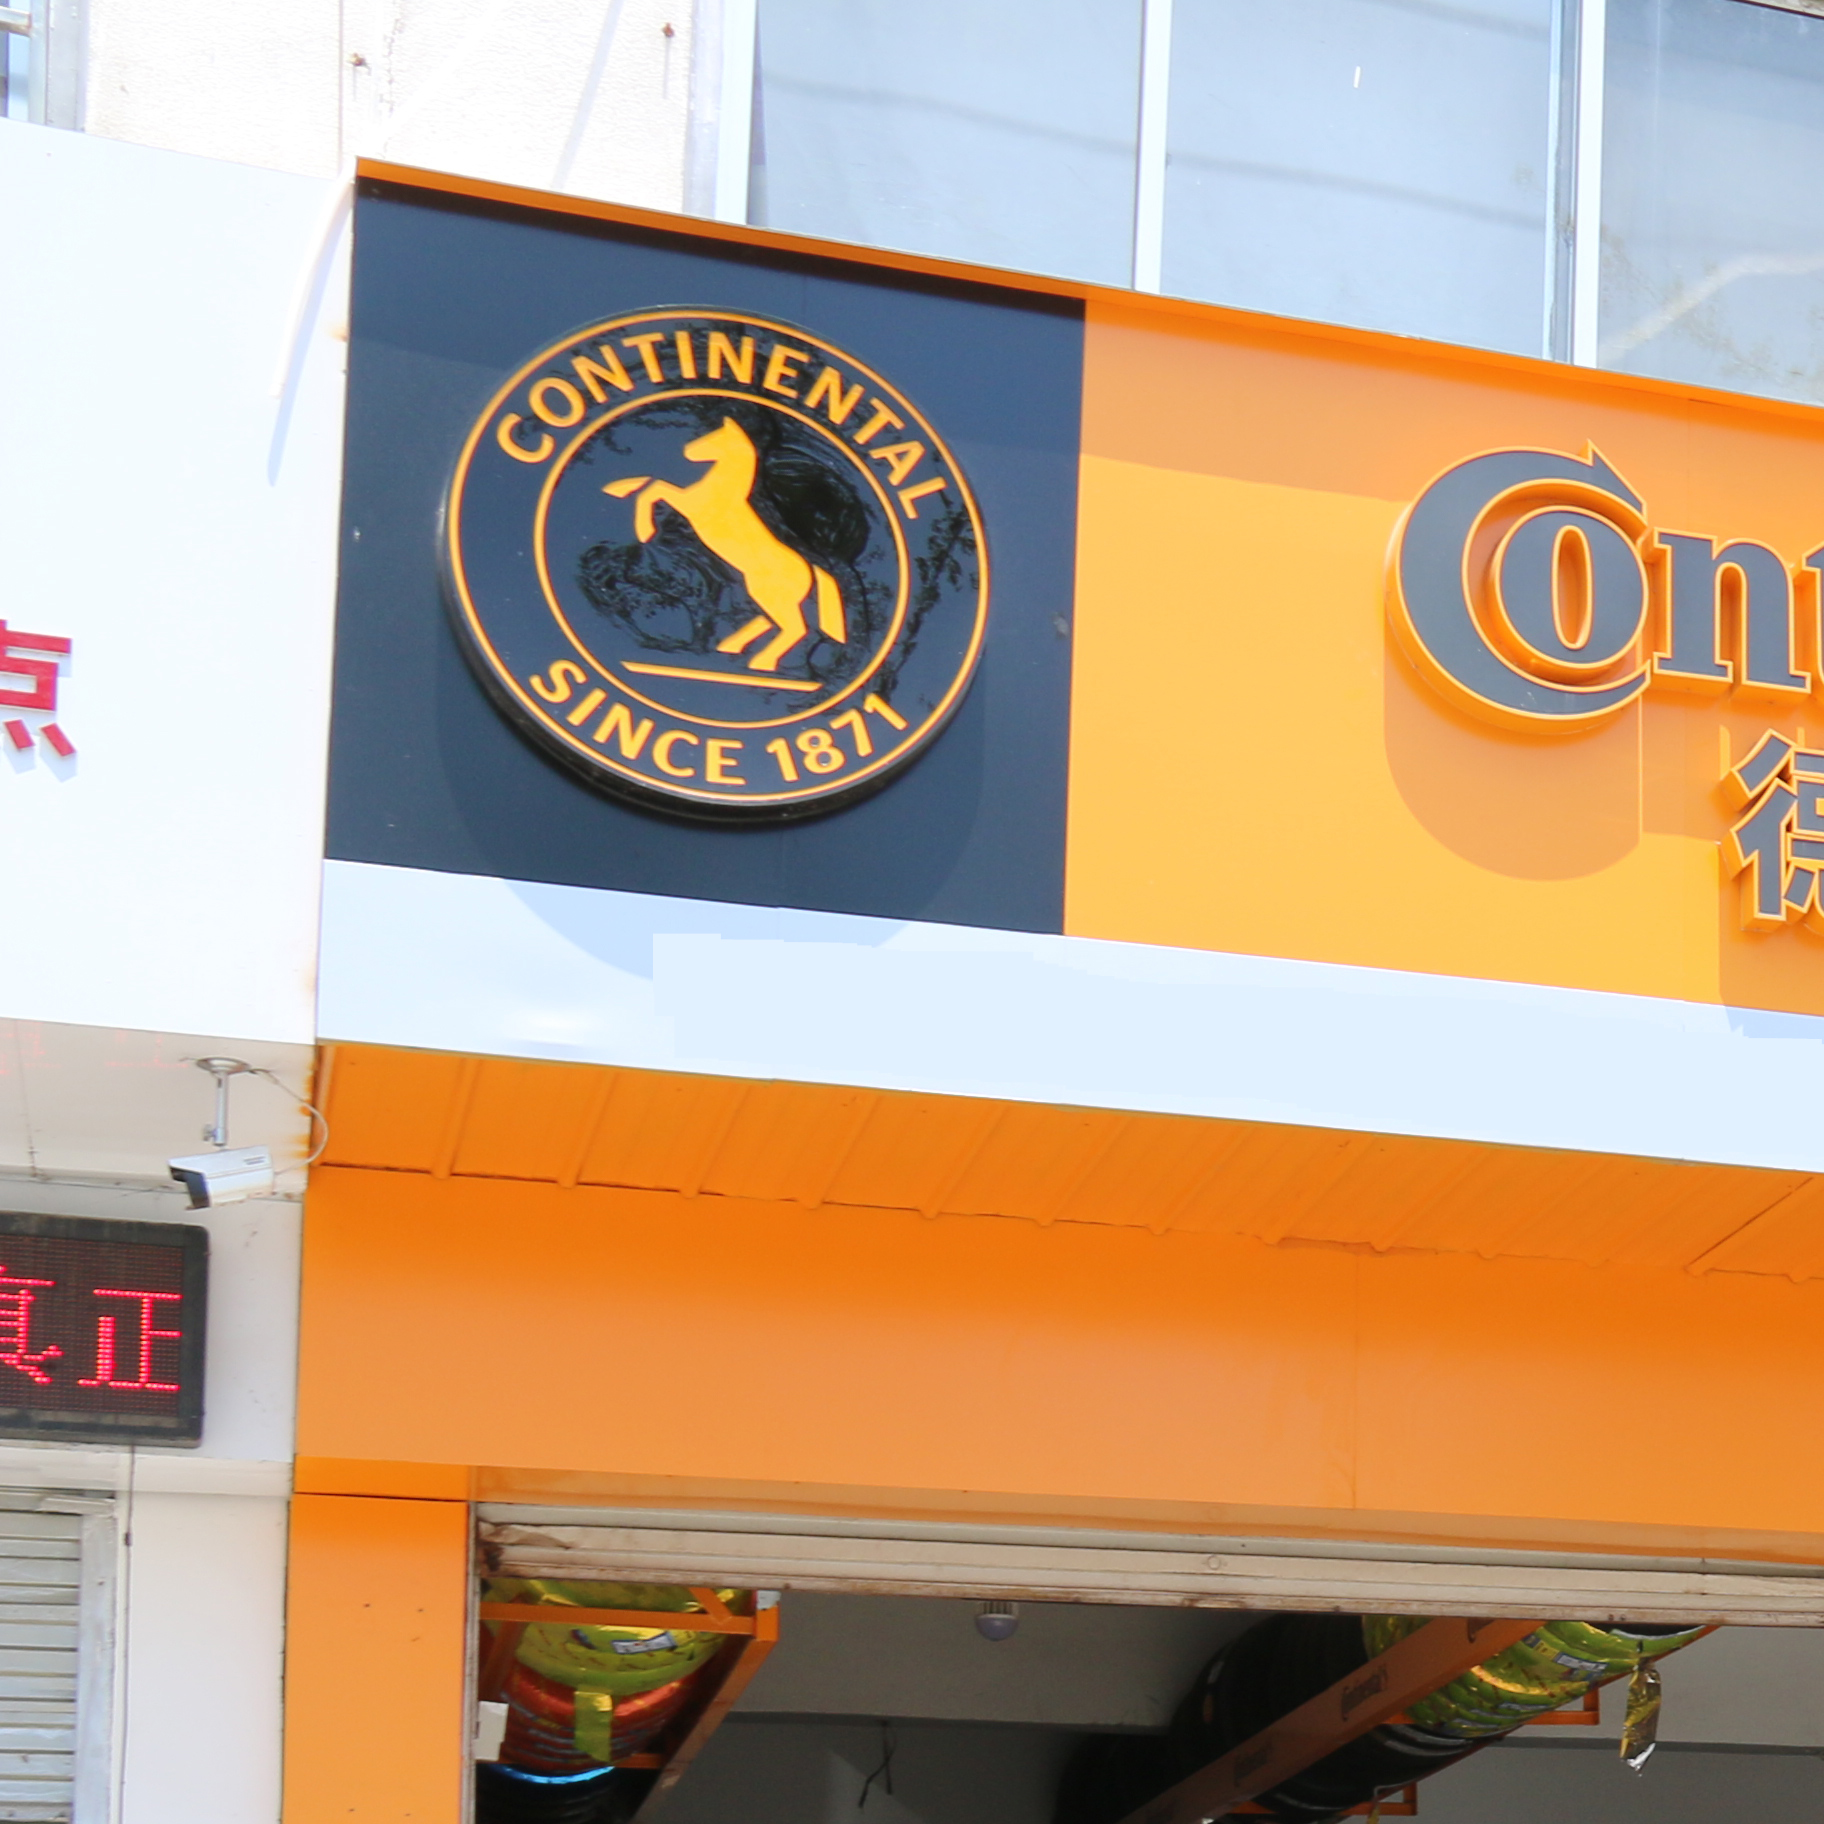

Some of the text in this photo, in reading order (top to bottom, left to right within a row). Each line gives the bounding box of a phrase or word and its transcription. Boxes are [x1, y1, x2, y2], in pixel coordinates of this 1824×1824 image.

[497, 330, 947, 520] CONTINENTAL
[530, 659, 908, 786] SINCE 1871
